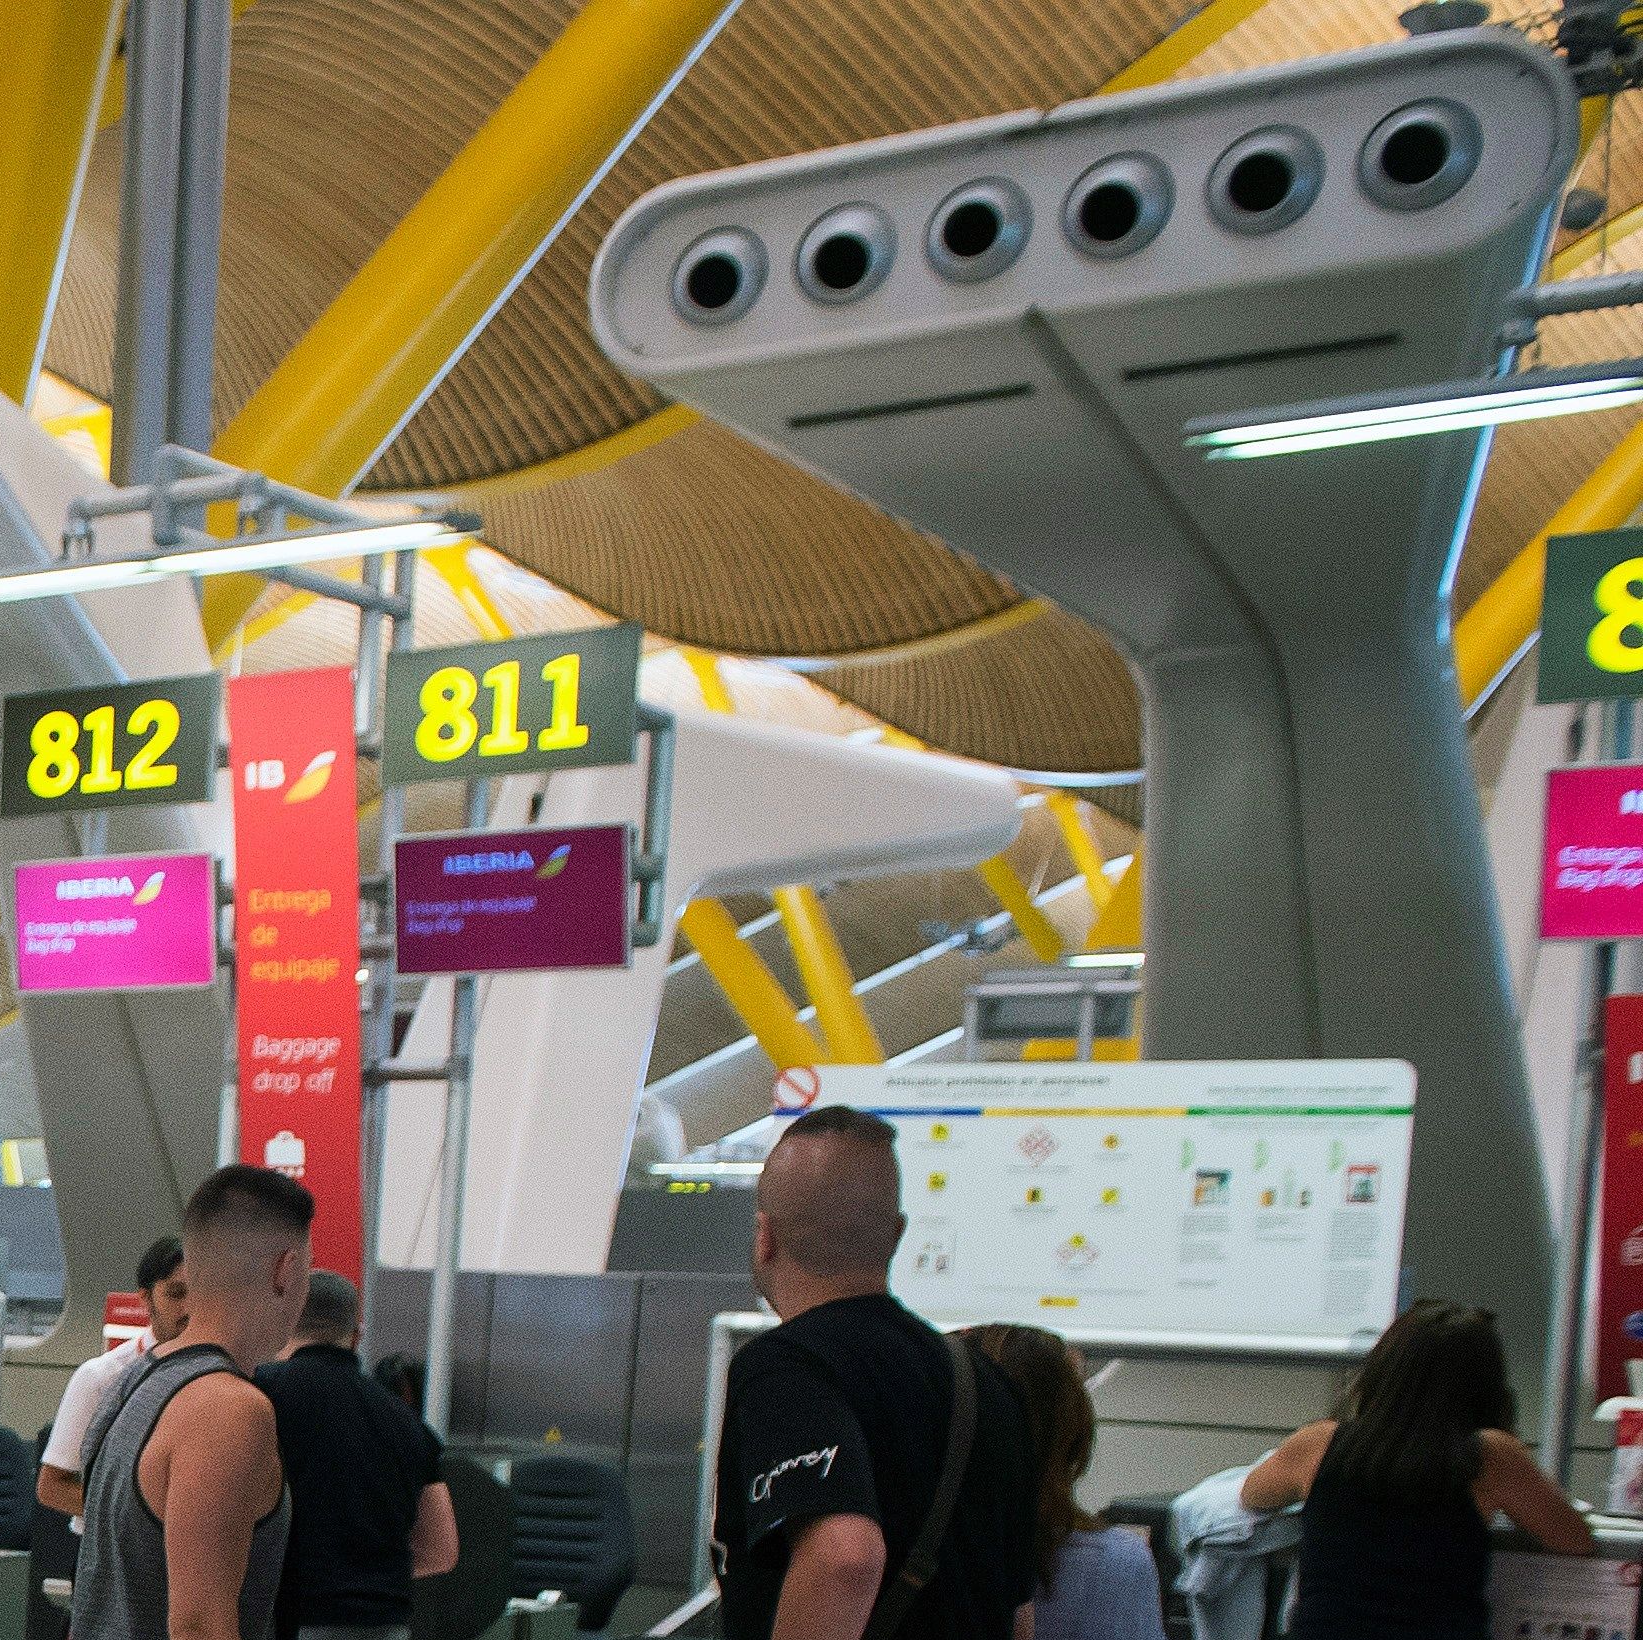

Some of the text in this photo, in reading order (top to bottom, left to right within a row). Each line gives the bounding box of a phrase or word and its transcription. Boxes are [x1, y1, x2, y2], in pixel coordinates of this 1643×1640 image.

[27, 699, 180, 798] 812
[416, 654, 589, 762] 811
[244, 759, 285, 791] IB
